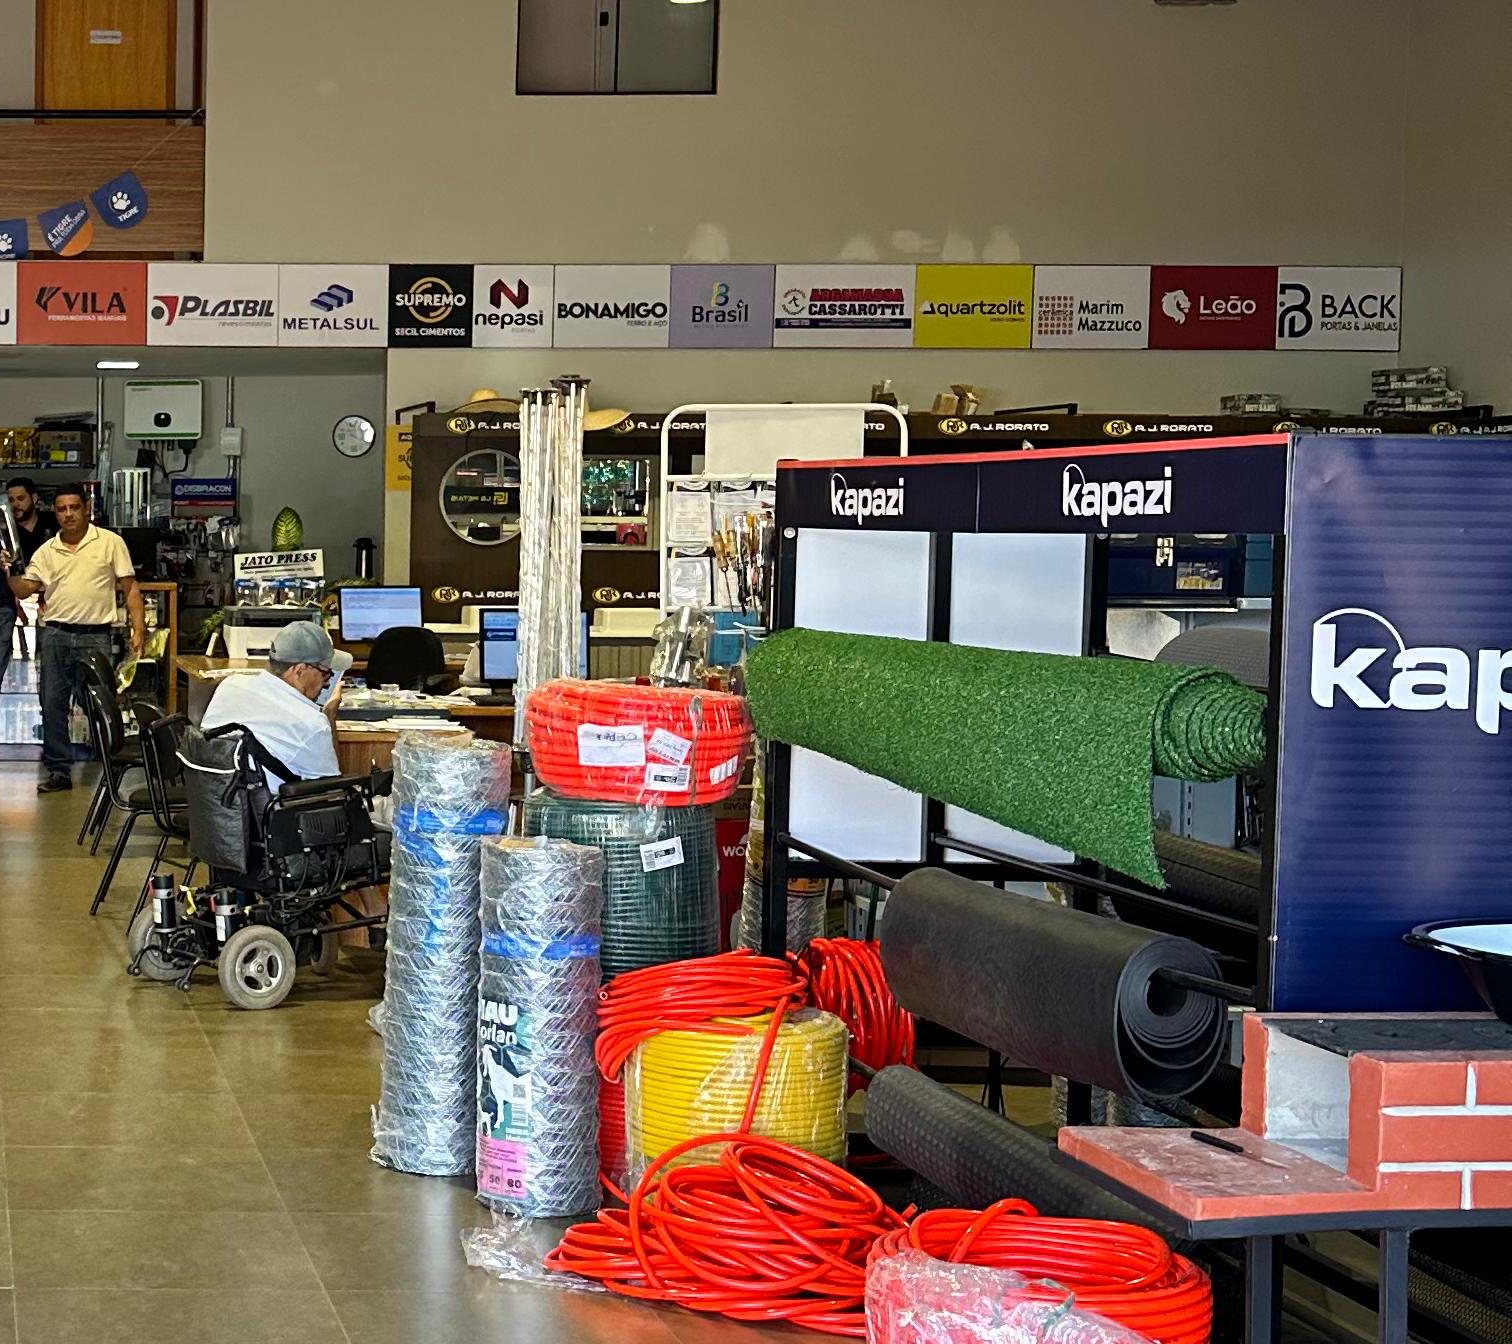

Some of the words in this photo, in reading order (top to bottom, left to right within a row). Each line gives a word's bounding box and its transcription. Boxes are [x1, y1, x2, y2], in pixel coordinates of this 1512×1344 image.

[118, 206, 139, 222] TIGRE
[53, 214, 72, 235] TIGRE
[63, 291, 126, 314] VILA
[178, 296, 275, 317] PLASBIL
[395, 293, 467, 307] SUPREMO
[1078, 300, 1124, 315] Marim
[1199, 295, 1256, 315] Leão
[1320, 294, 1397, 319] BACK
[557, 302, 668, 318] BONAMIGO
[808, 303, 905, 316] CASSAROTTI
[937, 300, 1025, 317] quartzolit
[282, 317, 380, 330] METALSUL
[474, 310, 544, 330] nepasi
[1078, 317, 1142, 332] Mazzuco
[1320, 320, 1351, 332] PORTAS
[1353, 321, 1359, 331] &
[1360, 320, 1398, 332] JANELAS
[394, 327, 419, 337] SECIL
[419, 327, 466, 337] CIMENTOS
[996, 423, 1049, 431] RORATO
[1160, 424, 1213, 432] RORATO
[830, 473, 904, 525] kapazi
[1063, 464, 1172, 528] kapazi
[240, 555, 274, 567] JATO
[276, 552, 318, 564] PRESS
[1311, 608, 1512, 735] kap
[722, 845, 746, 857] WO
[480, 1024, 518, 1046] orlan
